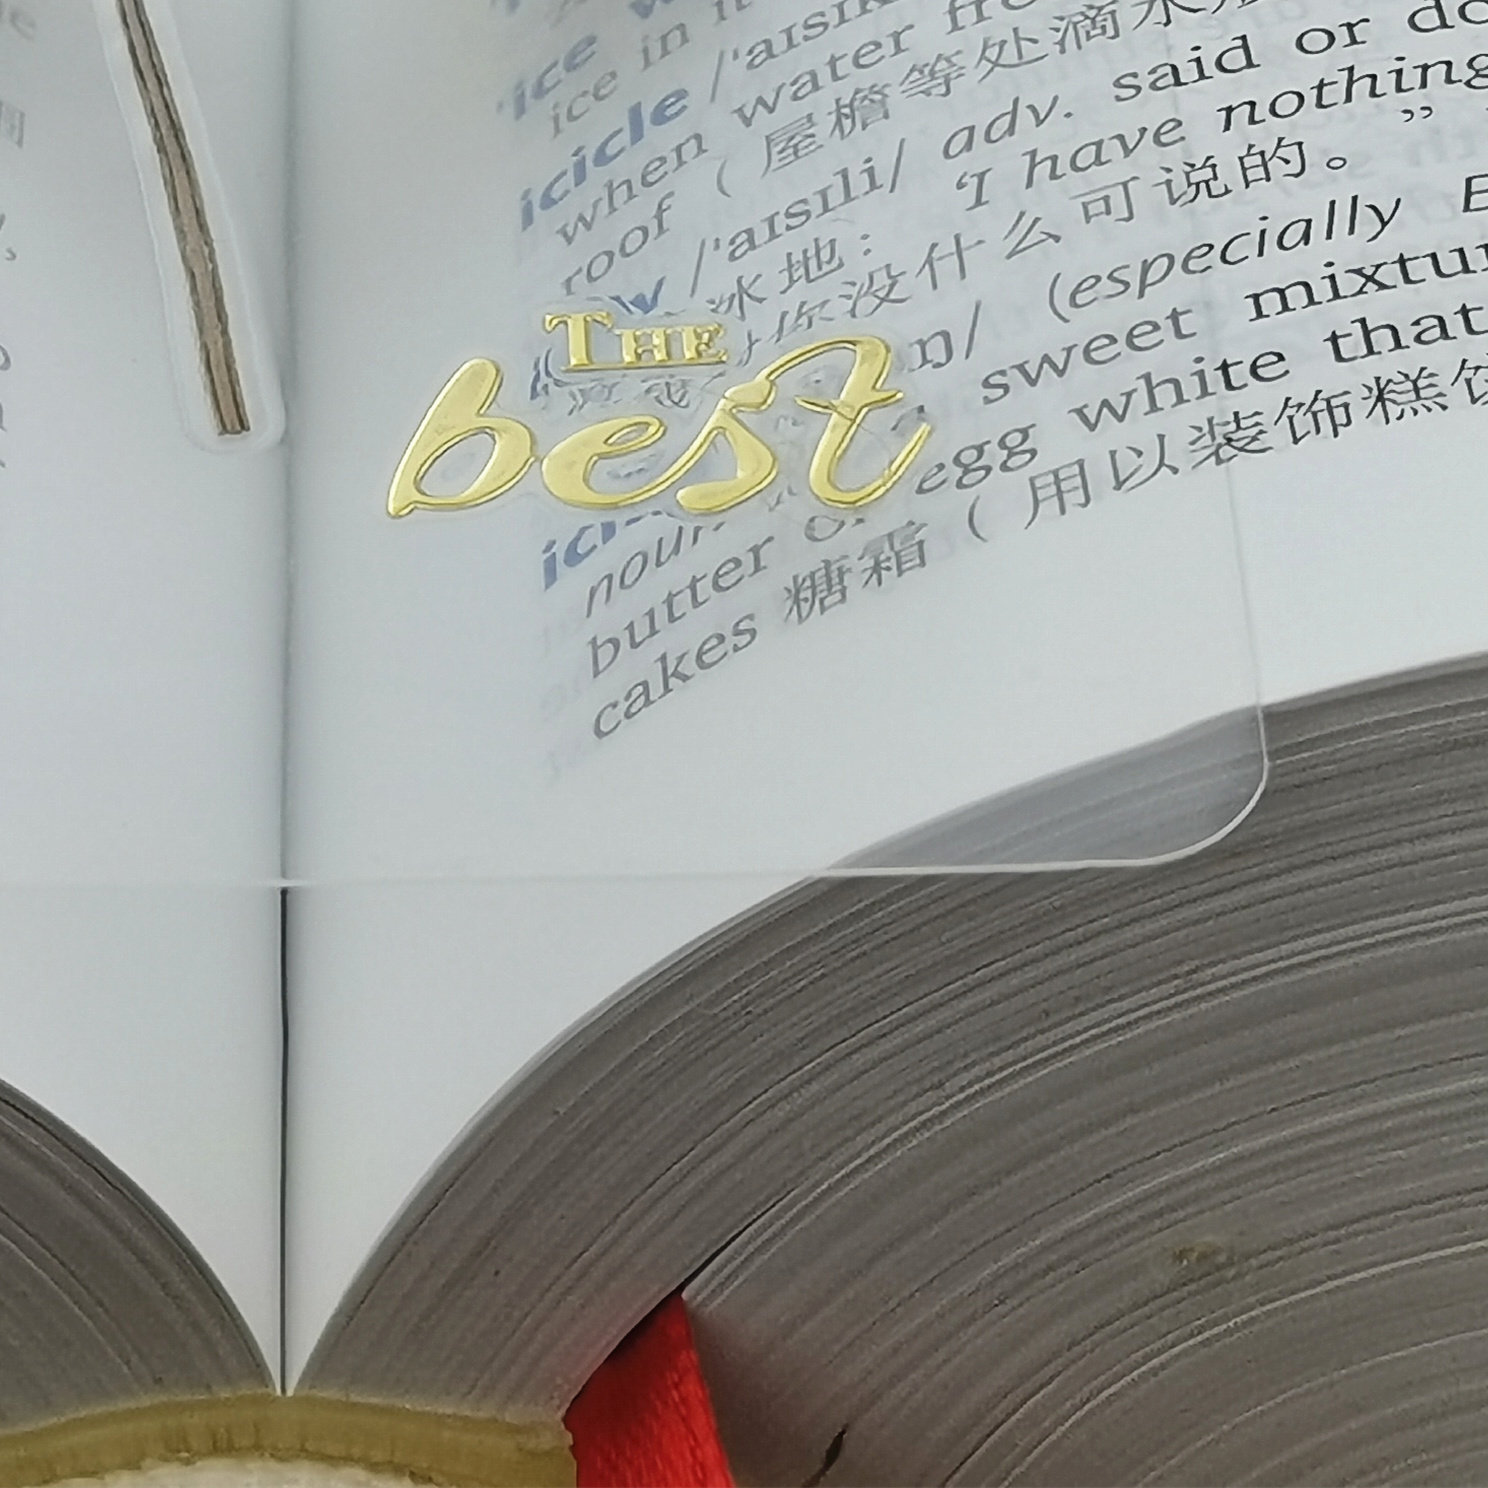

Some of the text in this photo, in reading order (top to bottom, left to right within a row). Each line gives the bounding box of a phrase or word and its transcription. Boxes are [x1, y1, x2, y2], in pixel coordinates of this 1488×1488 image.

[551, 68, 619, 140] ice
[640, 20, 690, 72] in
[556, 131, 708, 247] when
[731, 23, 915, 128] water
[943, 17, 1371, 160] adv. said or
[521, 87, 690, 232] icicle
[1021, 116, 1186, 190] have
[561, 191, 676, 296] roof
[1047, 195, 1403, 324] (especially
[914, 302, 1488, 497] egg white that
[979, 306, 1200, 406] sweet
[386, 336, 933, 519] best
[588, 536, 775, 679] butter
[592, 613, 759, 741] cakes
